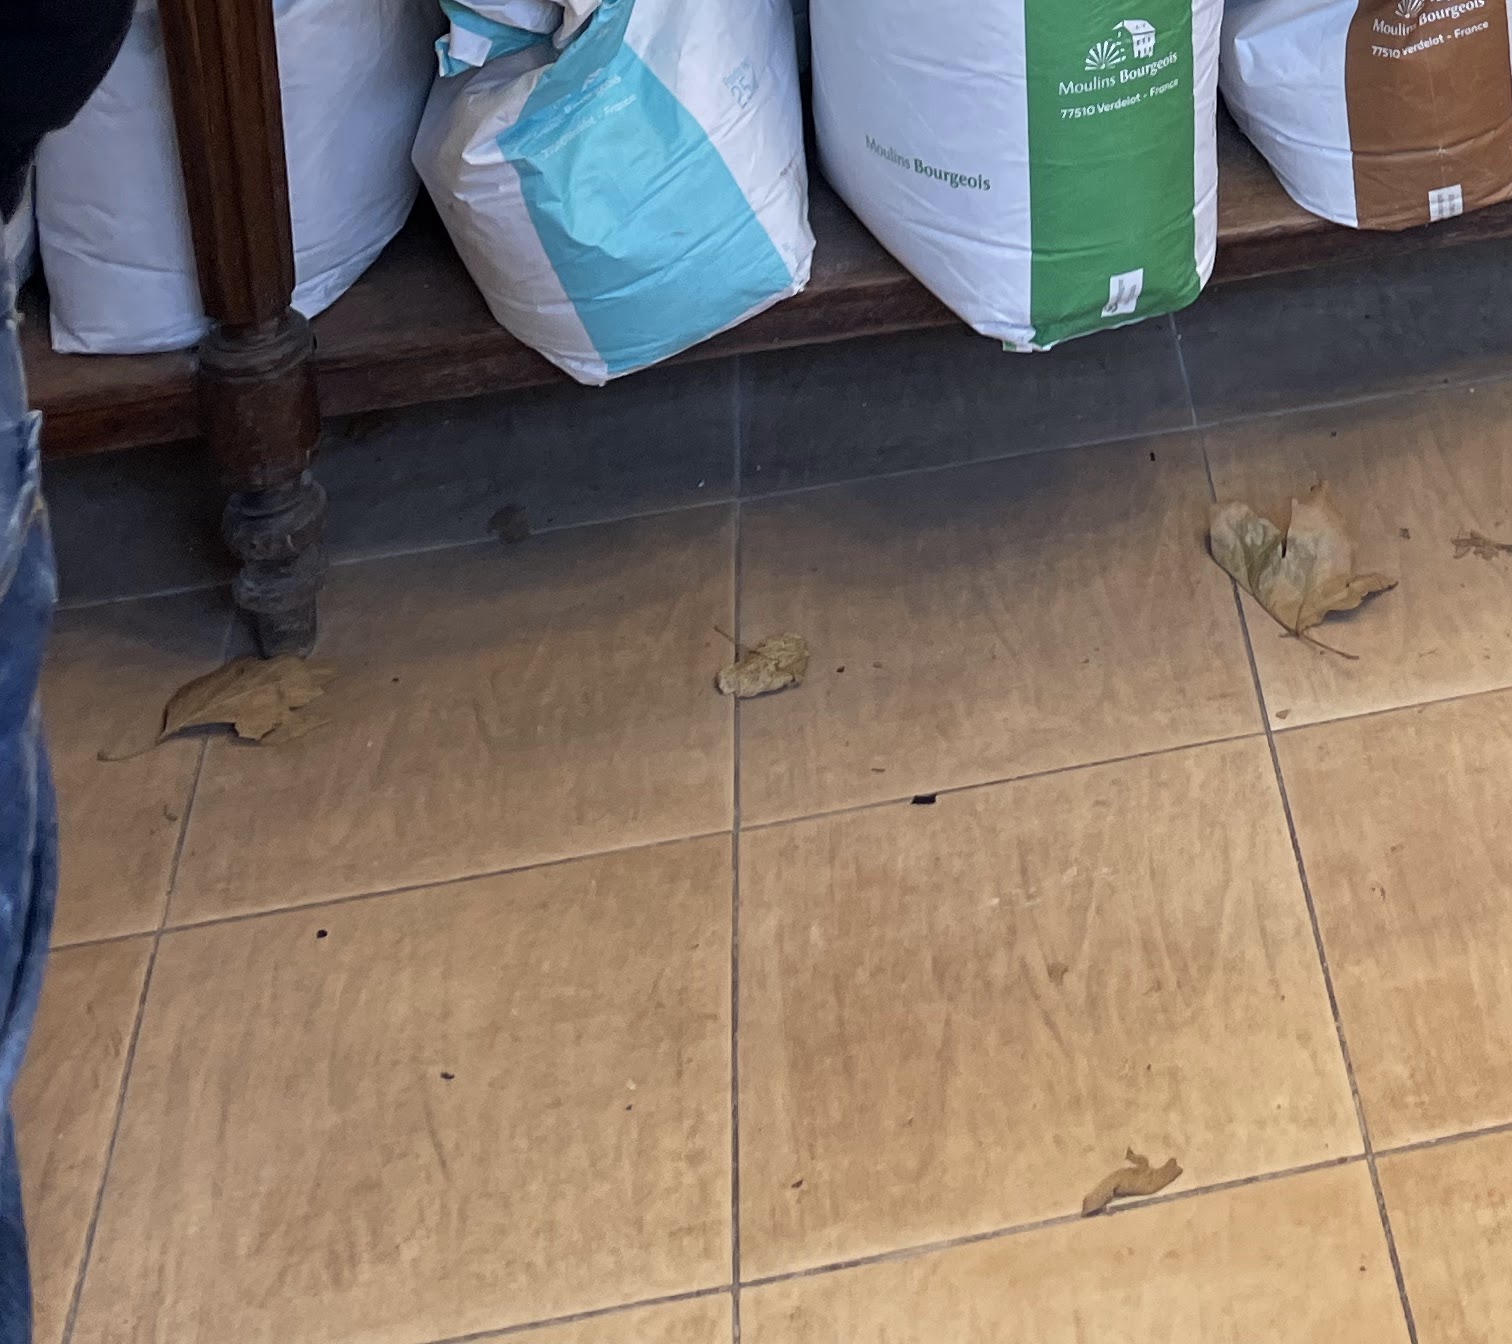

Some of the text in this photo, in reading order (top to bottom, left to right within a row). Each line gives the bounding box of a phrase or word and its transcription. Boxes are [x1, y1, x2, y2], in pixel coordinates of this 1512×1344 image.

[1371, 45, 1401, 59] 77510
[1454, 20, 1489, 39] France
[1058, 51, 1178, 96] Moulins Bourgeois
[1060, 105, 1096, 119] 77510
[1096, 93, 1141, 113] Verdelot
[1149, 78, 1179, 97] France
[865, 133, 991, 191] Moulins Bourgeois
